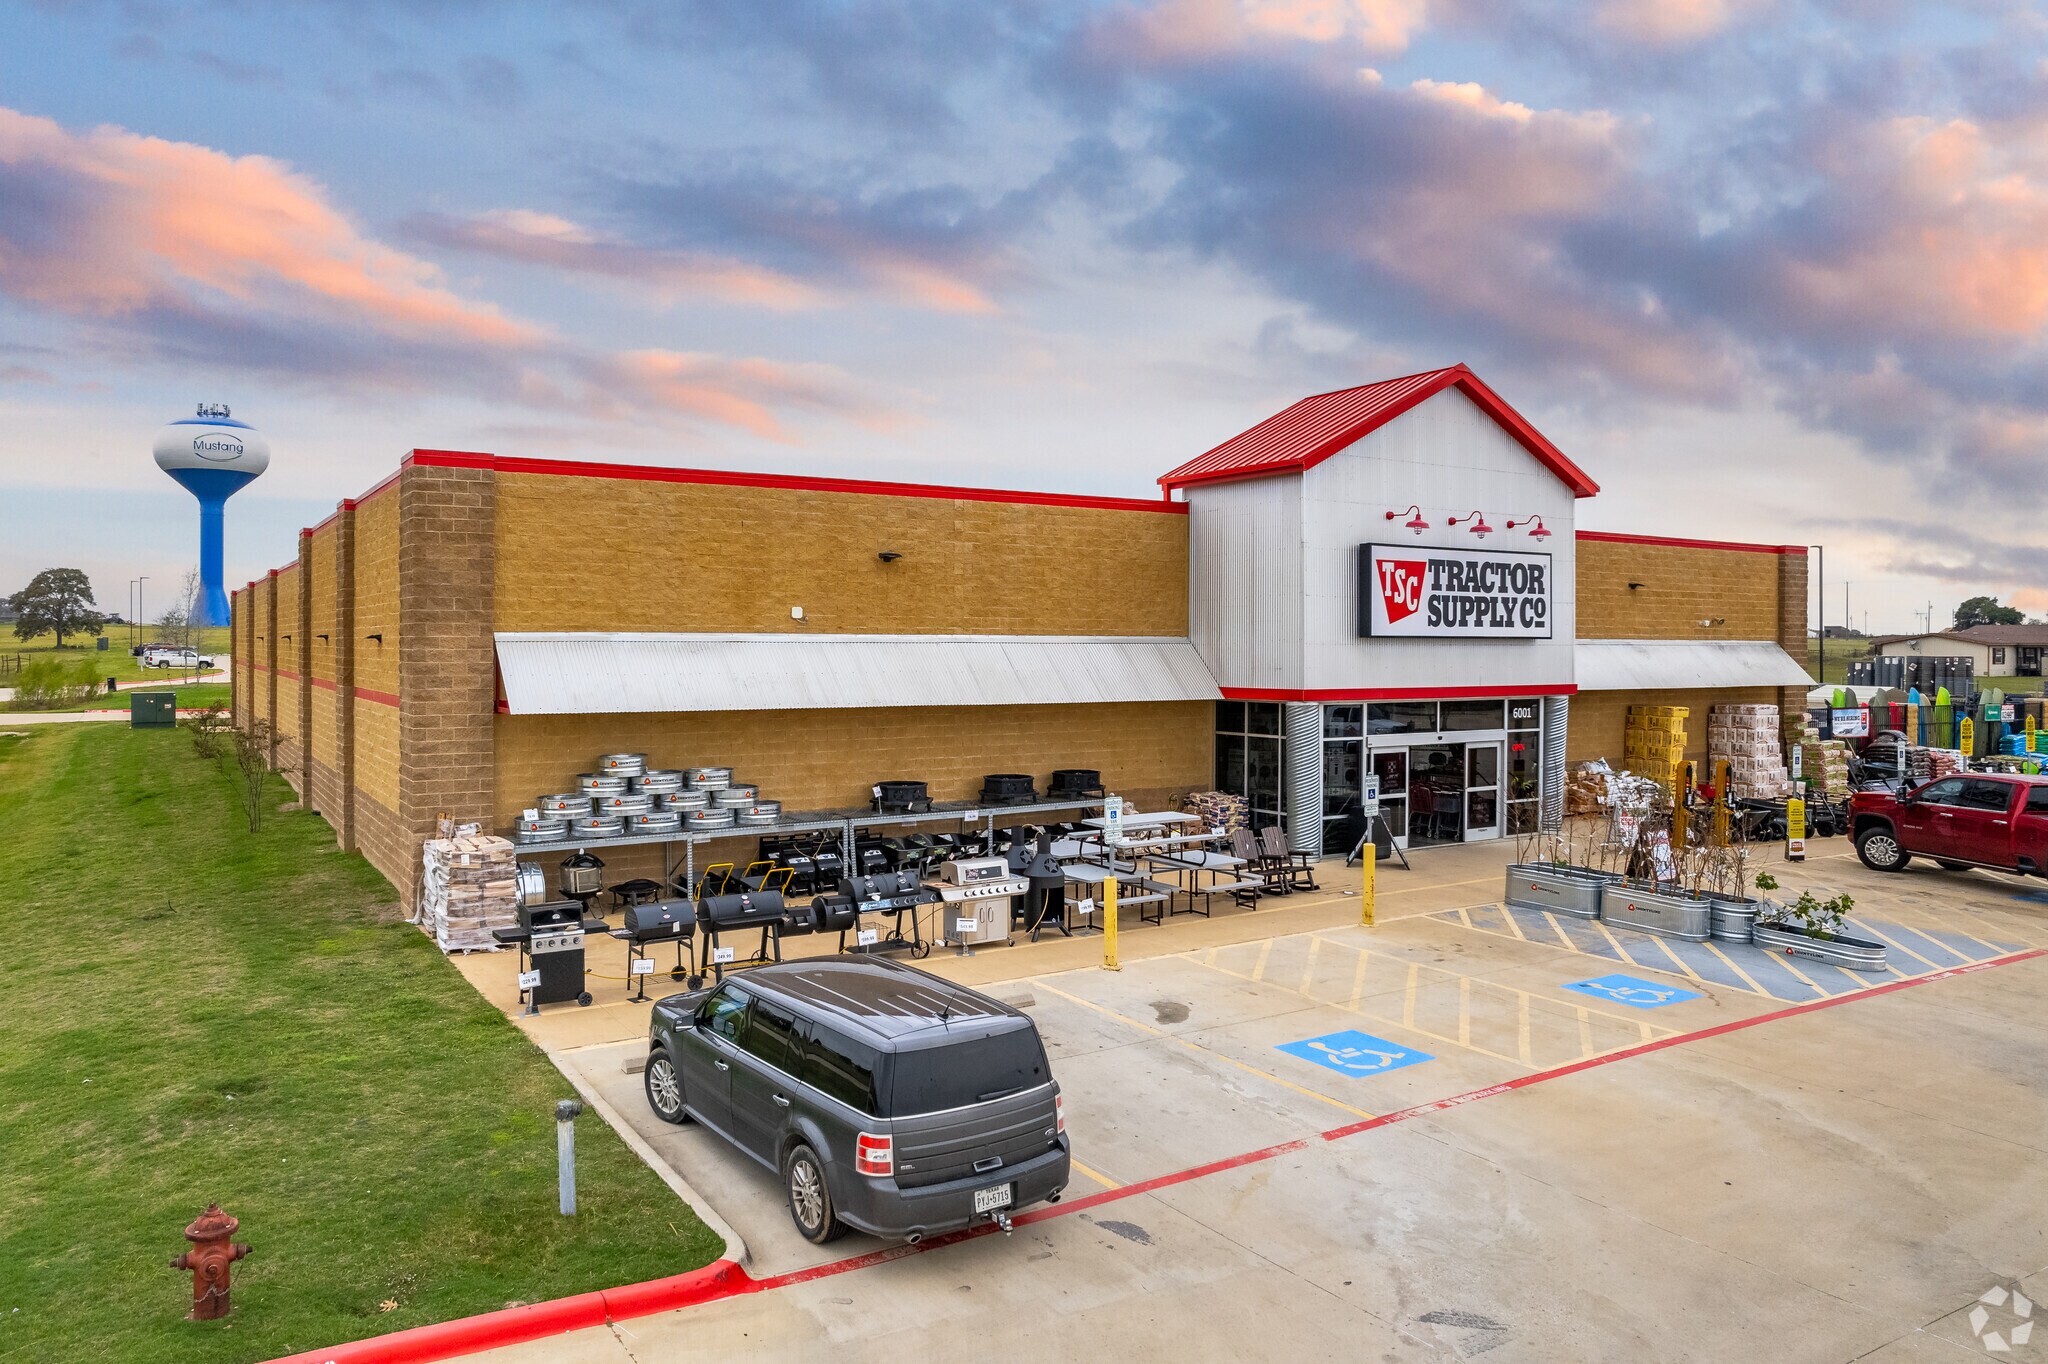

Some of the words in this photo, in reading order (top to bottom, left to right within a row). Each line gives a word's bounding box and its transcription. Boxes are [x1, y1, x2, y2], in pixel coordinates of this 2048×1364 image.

[193, 440, 244, 455] Mustang
[1381, 561, 1418, 611] TSC
[1428, 558, 1545, 595] TRACTOR
[1428, 594, 1517, 628] SUPPLY
[1512, 707, 1532, 719] 6001
